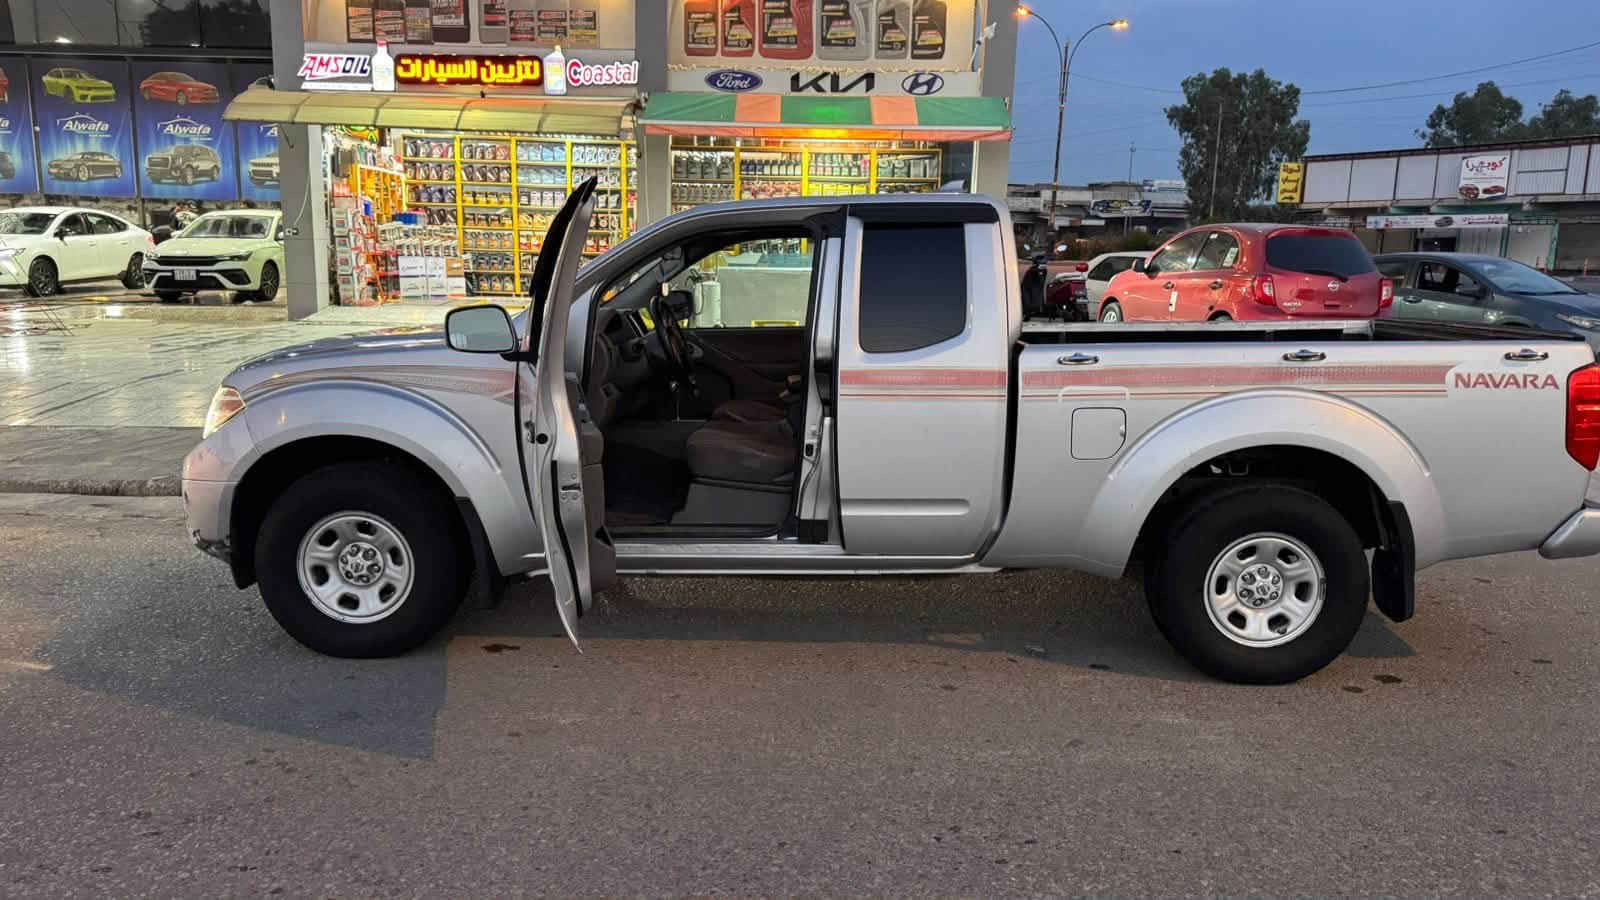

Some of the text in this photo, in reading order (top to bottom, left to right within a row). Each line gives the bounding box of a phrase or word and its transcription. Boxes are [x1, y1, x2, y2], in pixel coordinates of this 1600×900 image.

[301, 55, 370, 79] AMSOIL
[396, 59, 478, 82] السيارات
[567, 60, 637, 85] Coastal
[715, 73, 752, 90] Ford
[63, 119, 110, 131] Alwafa
[163, 123, 212, 135] Alwafa
[1454, 373, 1560, 390] NAVARA
